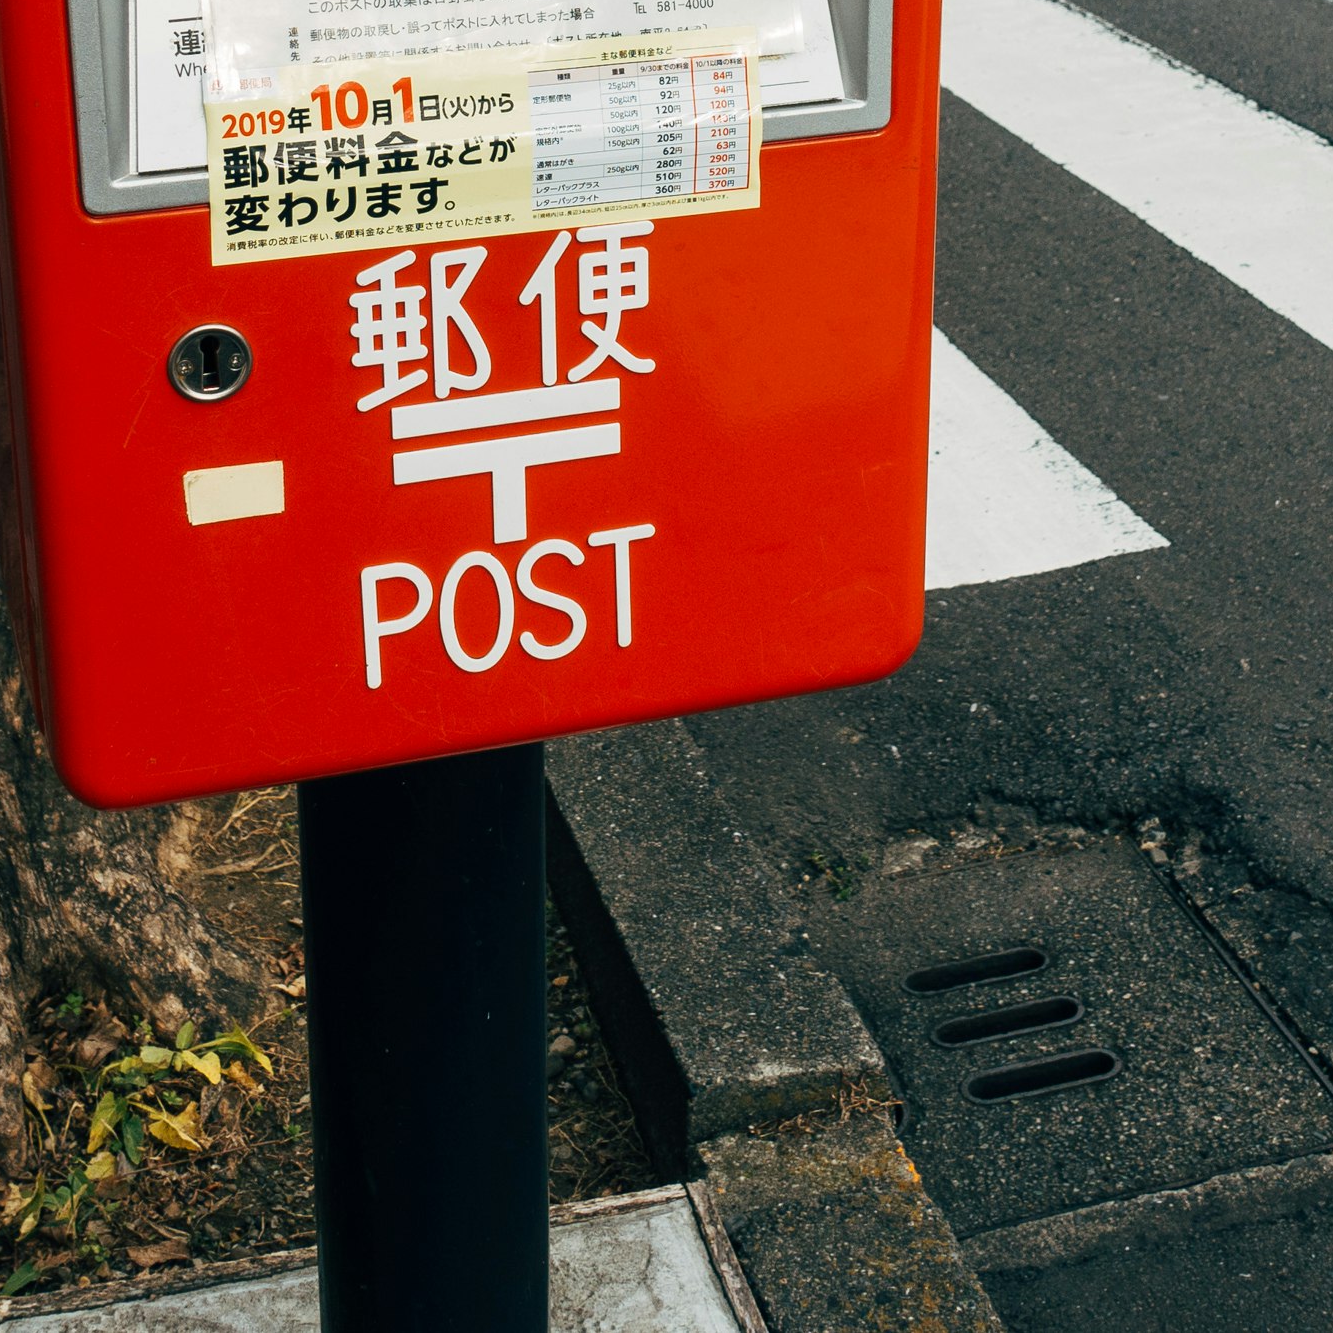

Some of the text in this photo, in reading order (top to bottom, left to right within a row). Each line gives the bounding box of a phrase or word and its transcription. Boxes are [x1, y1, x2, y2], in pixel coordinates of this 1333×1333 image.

[173, 29, 205, 57] 連
[601, 46, 673, 61] 主な郵便料金など
[659, 76, 679, 85] 82円
[713, 71, 733, 81] 84円
[608, 80, 636, 91] 25g以内
[714, 85, 734, 95] 94円
[609, 95, 637, 106] 50g以内
[660, 91, 680, 100] 92円
[656, 105, 681, 115] 120円
[710, 100, 735, 110] 120円
[610, 109, 639, 119] 50g以内
[710, 127, 736, 137] 210円
[608, 137, 640, 147] 150g以内
[657, 133, 683, 143] 205円
[663, 146, 683, 155] 62円
[716, 141, 736, 150] 63円
[223, 131, 518, 190] 郵便料金などが
[656, 159, 682, 169] 280円
[709, 154, 736, 164] 290円
[709, 167, 735, 176] 520円
[655, 172, 682, 182] 510円
[536, 181, 600, 195] レターパックプラス
[708, 180, 735, 189] 370円
[655, 185, 681, 195] 360円
[535, 194, 599, 208] レターパックライト
[225, 178, 456, 236] 変わります。
[226, 216, 517, 252] 消費税率の改定に伴い、郵便料金などを変更させていただきます。
[348, 221, 656, 412] 郵便
[361, 524, 656, 690] POST
